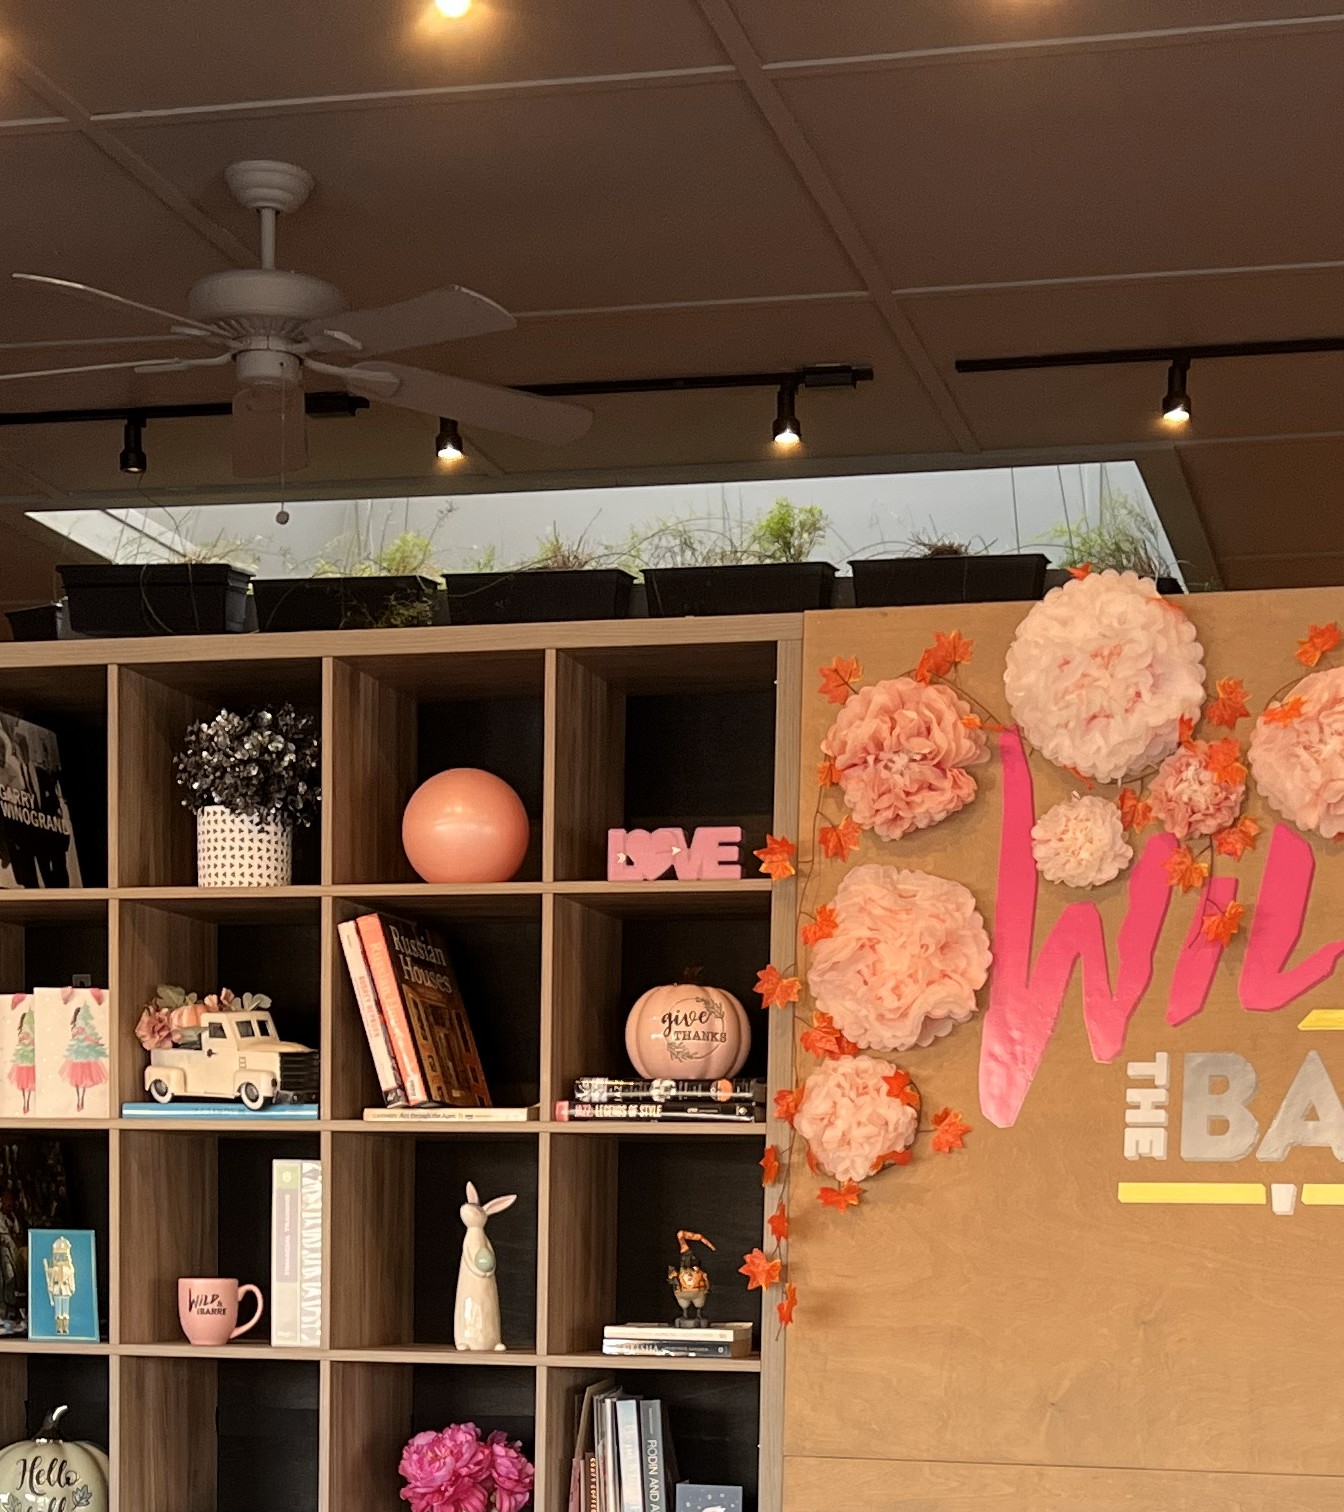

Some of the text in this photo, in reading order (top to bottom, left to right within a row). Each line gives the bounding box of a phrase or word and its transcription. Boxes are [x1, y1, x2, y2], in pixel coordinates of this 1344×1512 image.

[0, 800, 71, 836] WINOGRAND
[389, 925, 447, 967] Russian
[399, 954, 453, 994] Houses
[661, 1009, 712, 1038] give
[674, 1030, 727, 1043] THANKS
[595, 1104, 627, 1118] LEGENDS
[628, 1104, 638, 1118] OF
[638, 1104, 662, 1118] STYLE
[1123, 1051, 1170, 1161] THE
[646, 1439, 657, 1475] RODIN
[16, 1455, 80, 1496] Hello
[648, 1478, 660, 1502] AND
